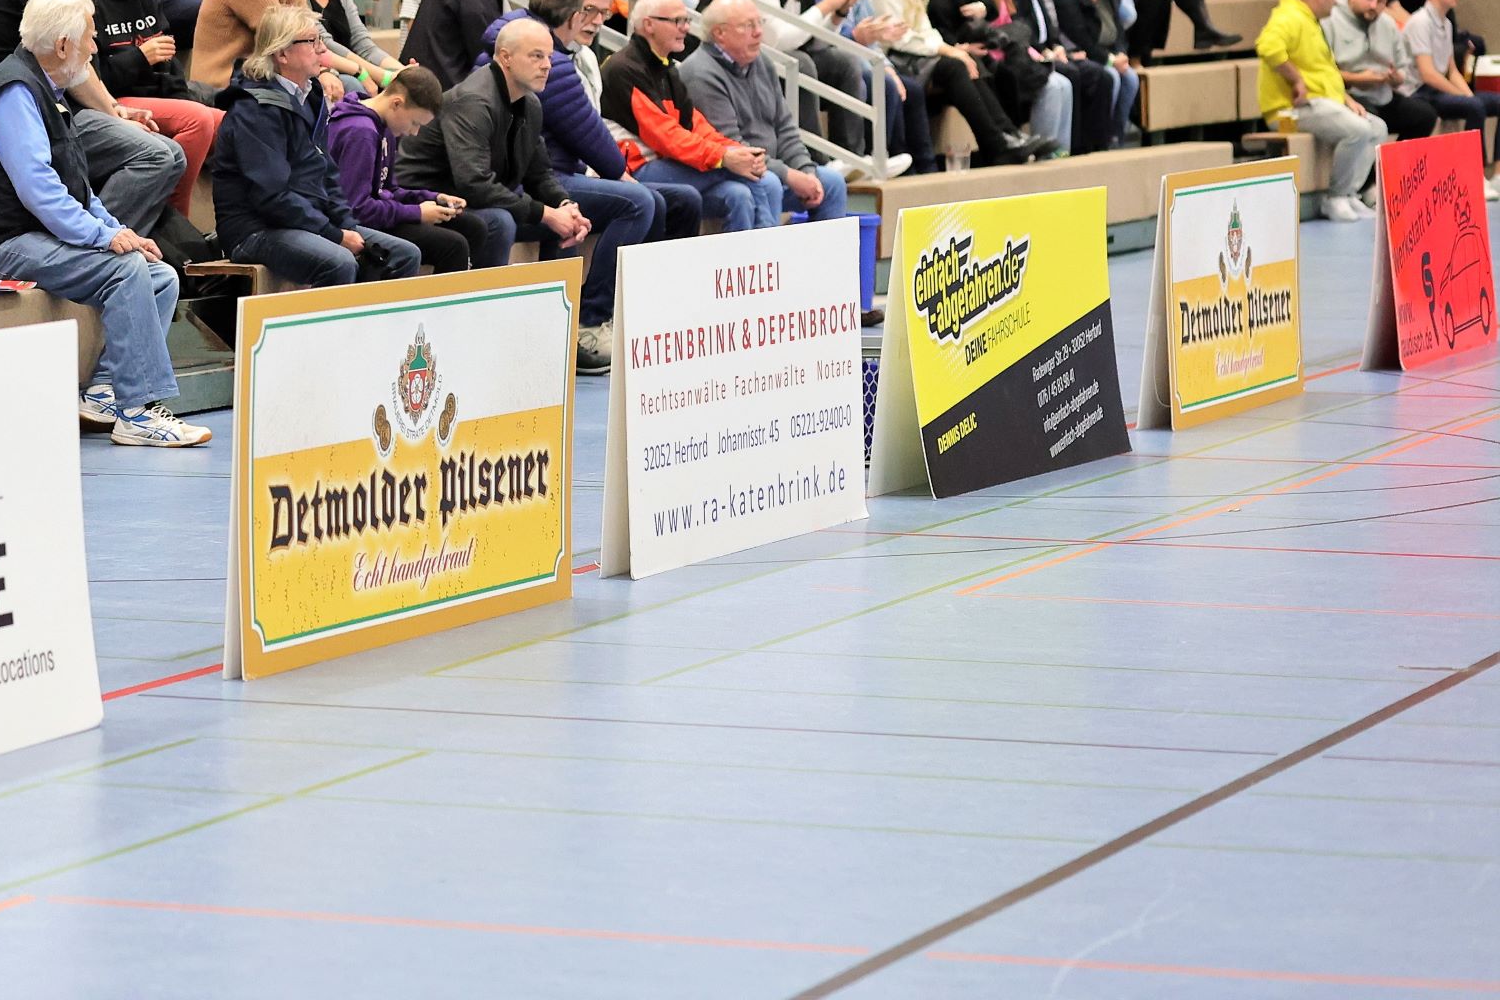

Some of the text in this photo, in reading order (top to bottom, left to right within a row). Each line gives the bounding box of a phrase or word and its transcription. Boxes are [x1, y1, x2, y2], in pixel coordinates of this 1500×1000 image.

[1432, 168, 1458, 217] Pflege
[714, 261, 780, 299] KANZLEI
[915, 241, 960, 305] einfach
[930, 245, 1020, 334] -abgefahren.de
[630, 301, 857, 370] KATENBRINK & DEPENBROCK
[964, 302, 1031, 366] DEINE FAHRSCHULE
[1179, 288, 1292, 347] Detmolder Pilsener
[640, 359, 852, 416] Rechtsanwälte Fachanwälte Notare
[643, 404, 852, 472] 32052 Herford Johannisstr. 45 05221-92400-0
[937, 411, 978, 455] DENNIS DELIC
[267, 449, 550, 553] Detmolder Pilsener
[653, 460, 846, 537] www.ra-katenbrink.de
[352, 537, 477, 592] Echt handgebraut
